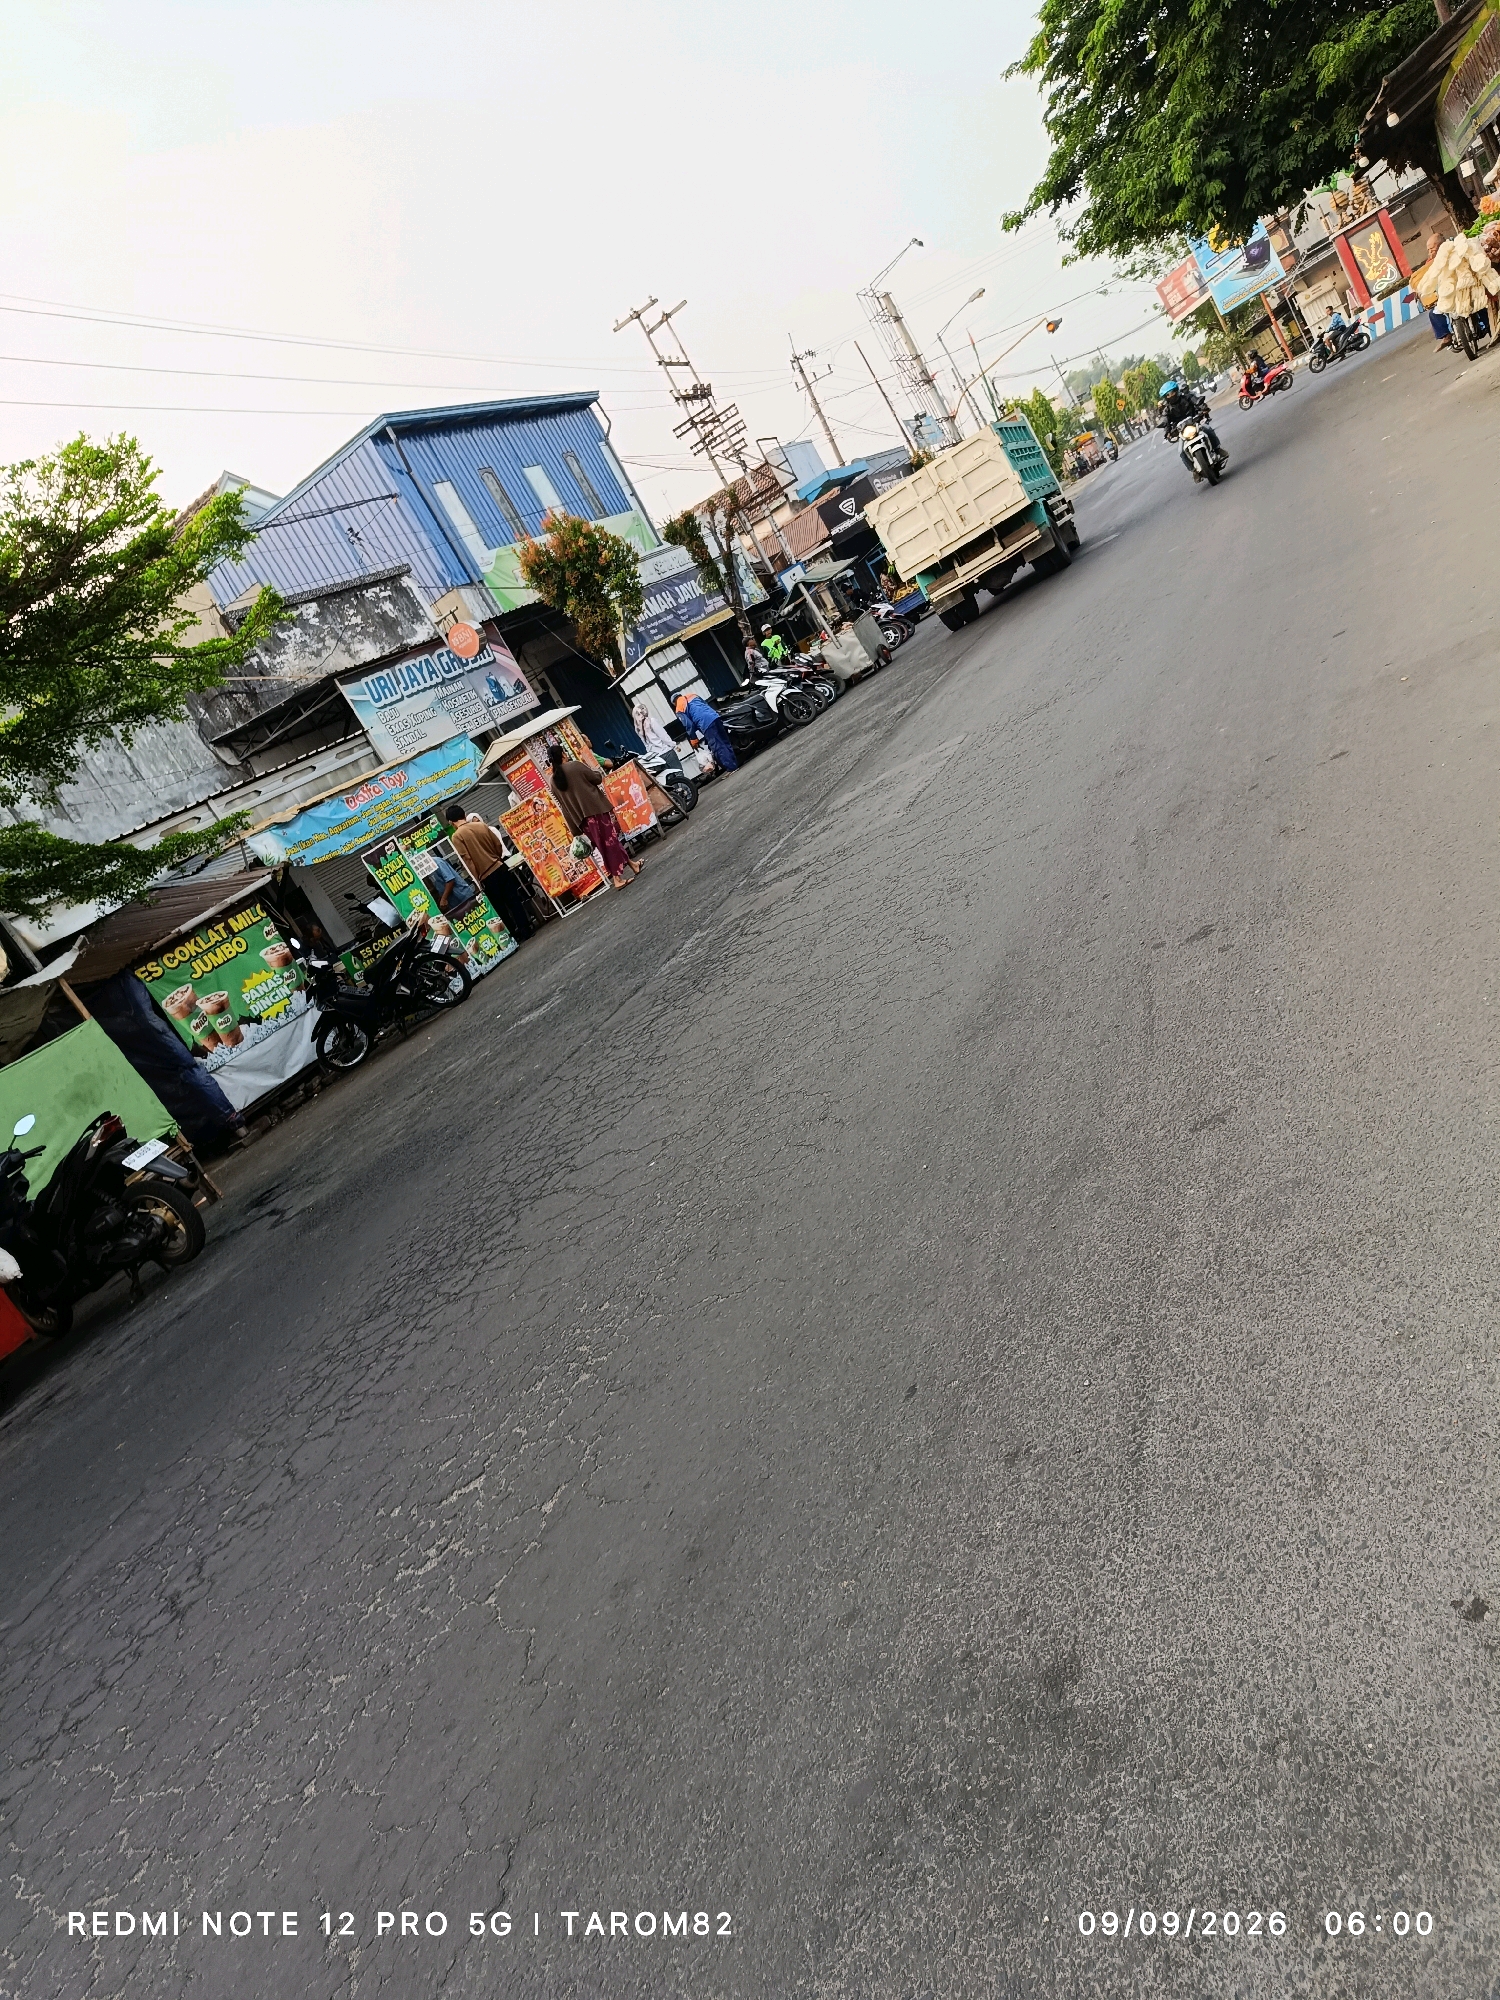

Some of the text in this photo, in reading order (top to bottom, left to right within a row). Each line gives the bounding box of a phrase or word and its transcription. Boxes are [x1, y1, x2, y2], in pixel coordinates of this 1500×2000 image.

[675, 580, 704, 603] JAYA
[364, 672, 399, 704] URI
[395, 657, 440, 692] JAYA
[434, 680, 464, 700] MAINAN
[441, 689, 479, 711] KOSMETIK
[506, 692, 535, 712] SEKOLAH
[376, 707, 401, 725] BAJU
[385, 707, 438, 737] EMAS XUPING
[393, 730, 427, 750] SANDAL
[378, 769, 409, 791] Toys
[328, 814, 362, 836] Aquarium,
[403, 824, 432, 846] ES COKLAT
[415, 836, 430, 848] MILO
[375, 868, 387, 880] ES
[383, 854, 406, 876] COKLAT
[385, 867, 414, 895] MILO
[412, 893, 427, 907] 5K
[454, 902, 489, 933] ES COKLAT
[467, 918, 486, 936] MILO
[134, 961, 165, 982] ES
[162, 923, 227, 969] COKLAT
[360, 946, 373, 958] ES
[481, 937, 495, 951] 5K
[191, 936, 248, 980] JUMBO
[242, 974, 284, 1004] PANAS
[250, 985, 292, 1016] DINGIN
